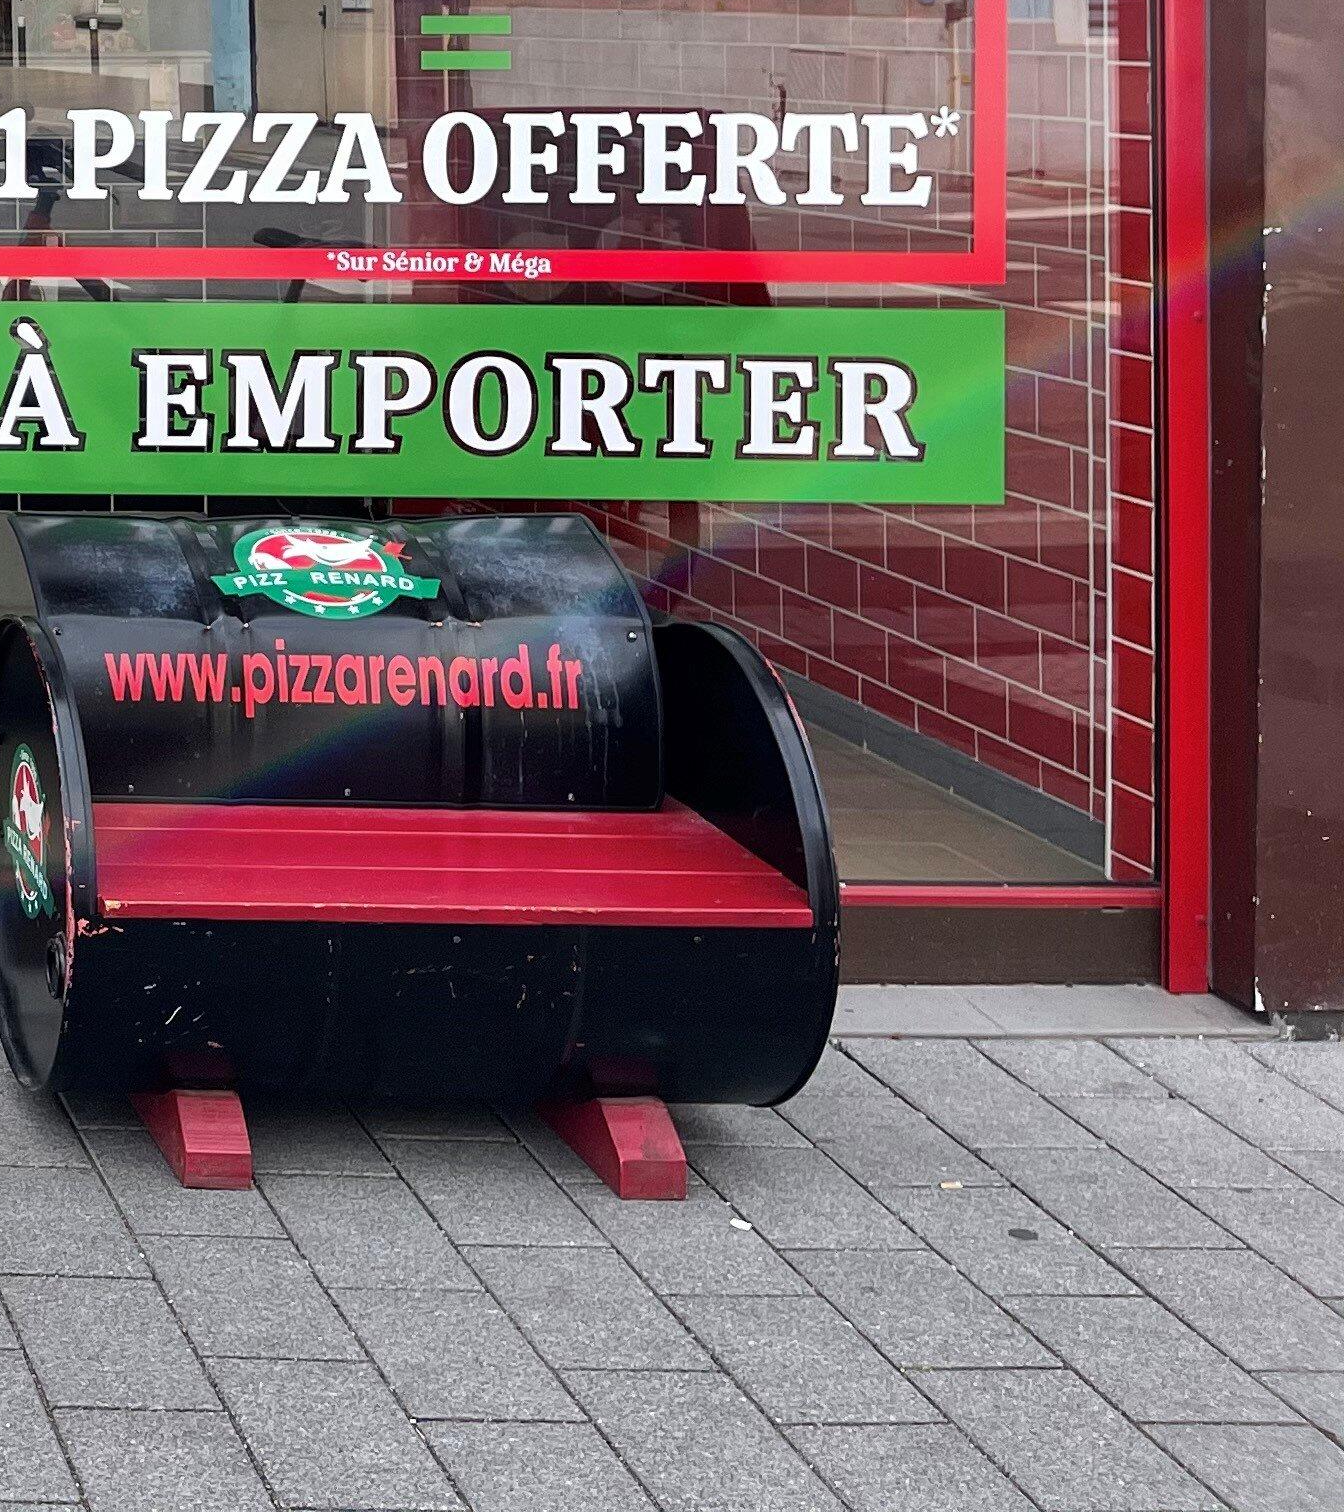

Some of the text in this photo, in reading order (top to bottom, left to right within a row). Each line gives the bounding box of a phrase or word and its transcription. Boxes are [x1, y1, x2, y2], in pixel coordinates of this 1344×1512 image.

[67, 107, 404, 205] PIZZA
[382, 249, 459, 274] Sénior
[463, 251, 485, 274] &
[488, 248, 553, 281] Méga
[131, 348, 926, 463] EMPORTER
[311, 571, 415, 591] RENARD
[105, 638, 584, 718] www.pizzarenard.fr
